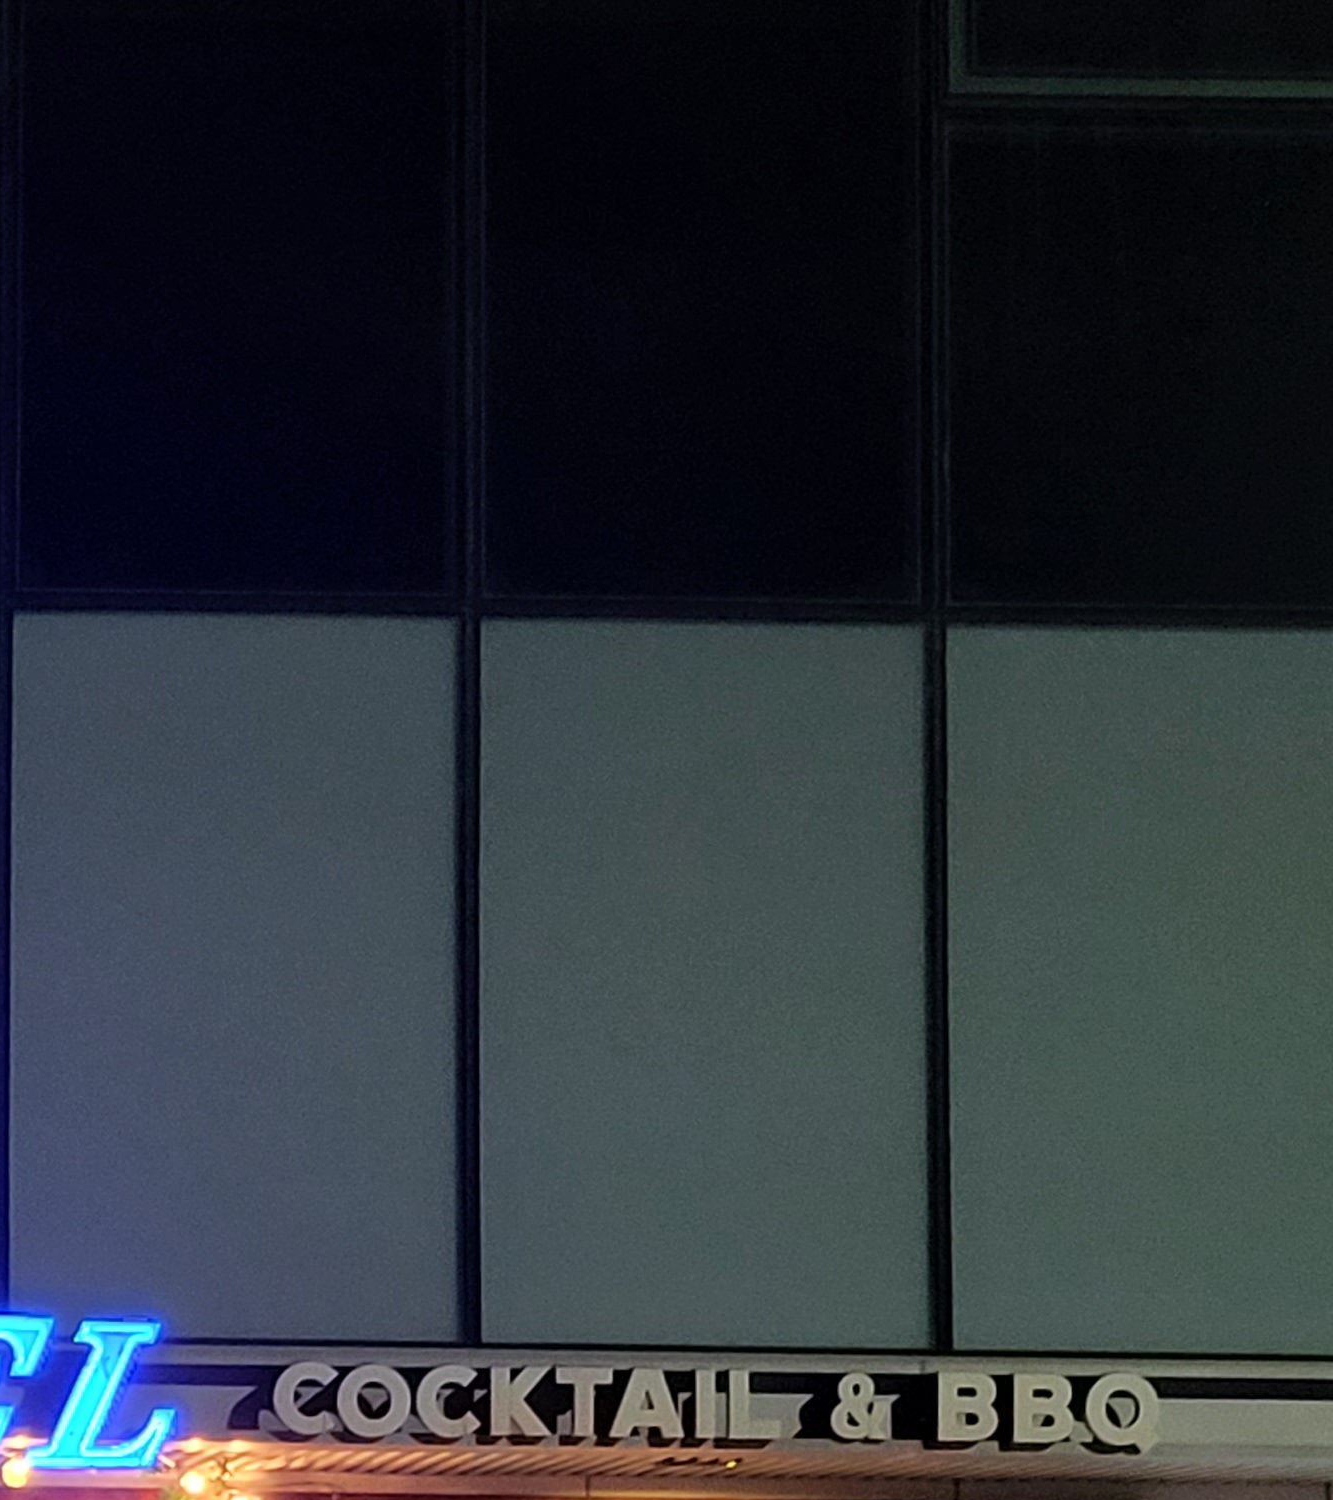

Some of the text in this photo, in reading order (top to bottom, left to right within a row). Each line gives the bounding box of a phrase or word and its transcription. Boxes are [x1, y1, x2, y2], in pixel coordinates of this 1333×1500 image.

[272, 1360, 1161, 1453] COCKTAIL & BBQ
